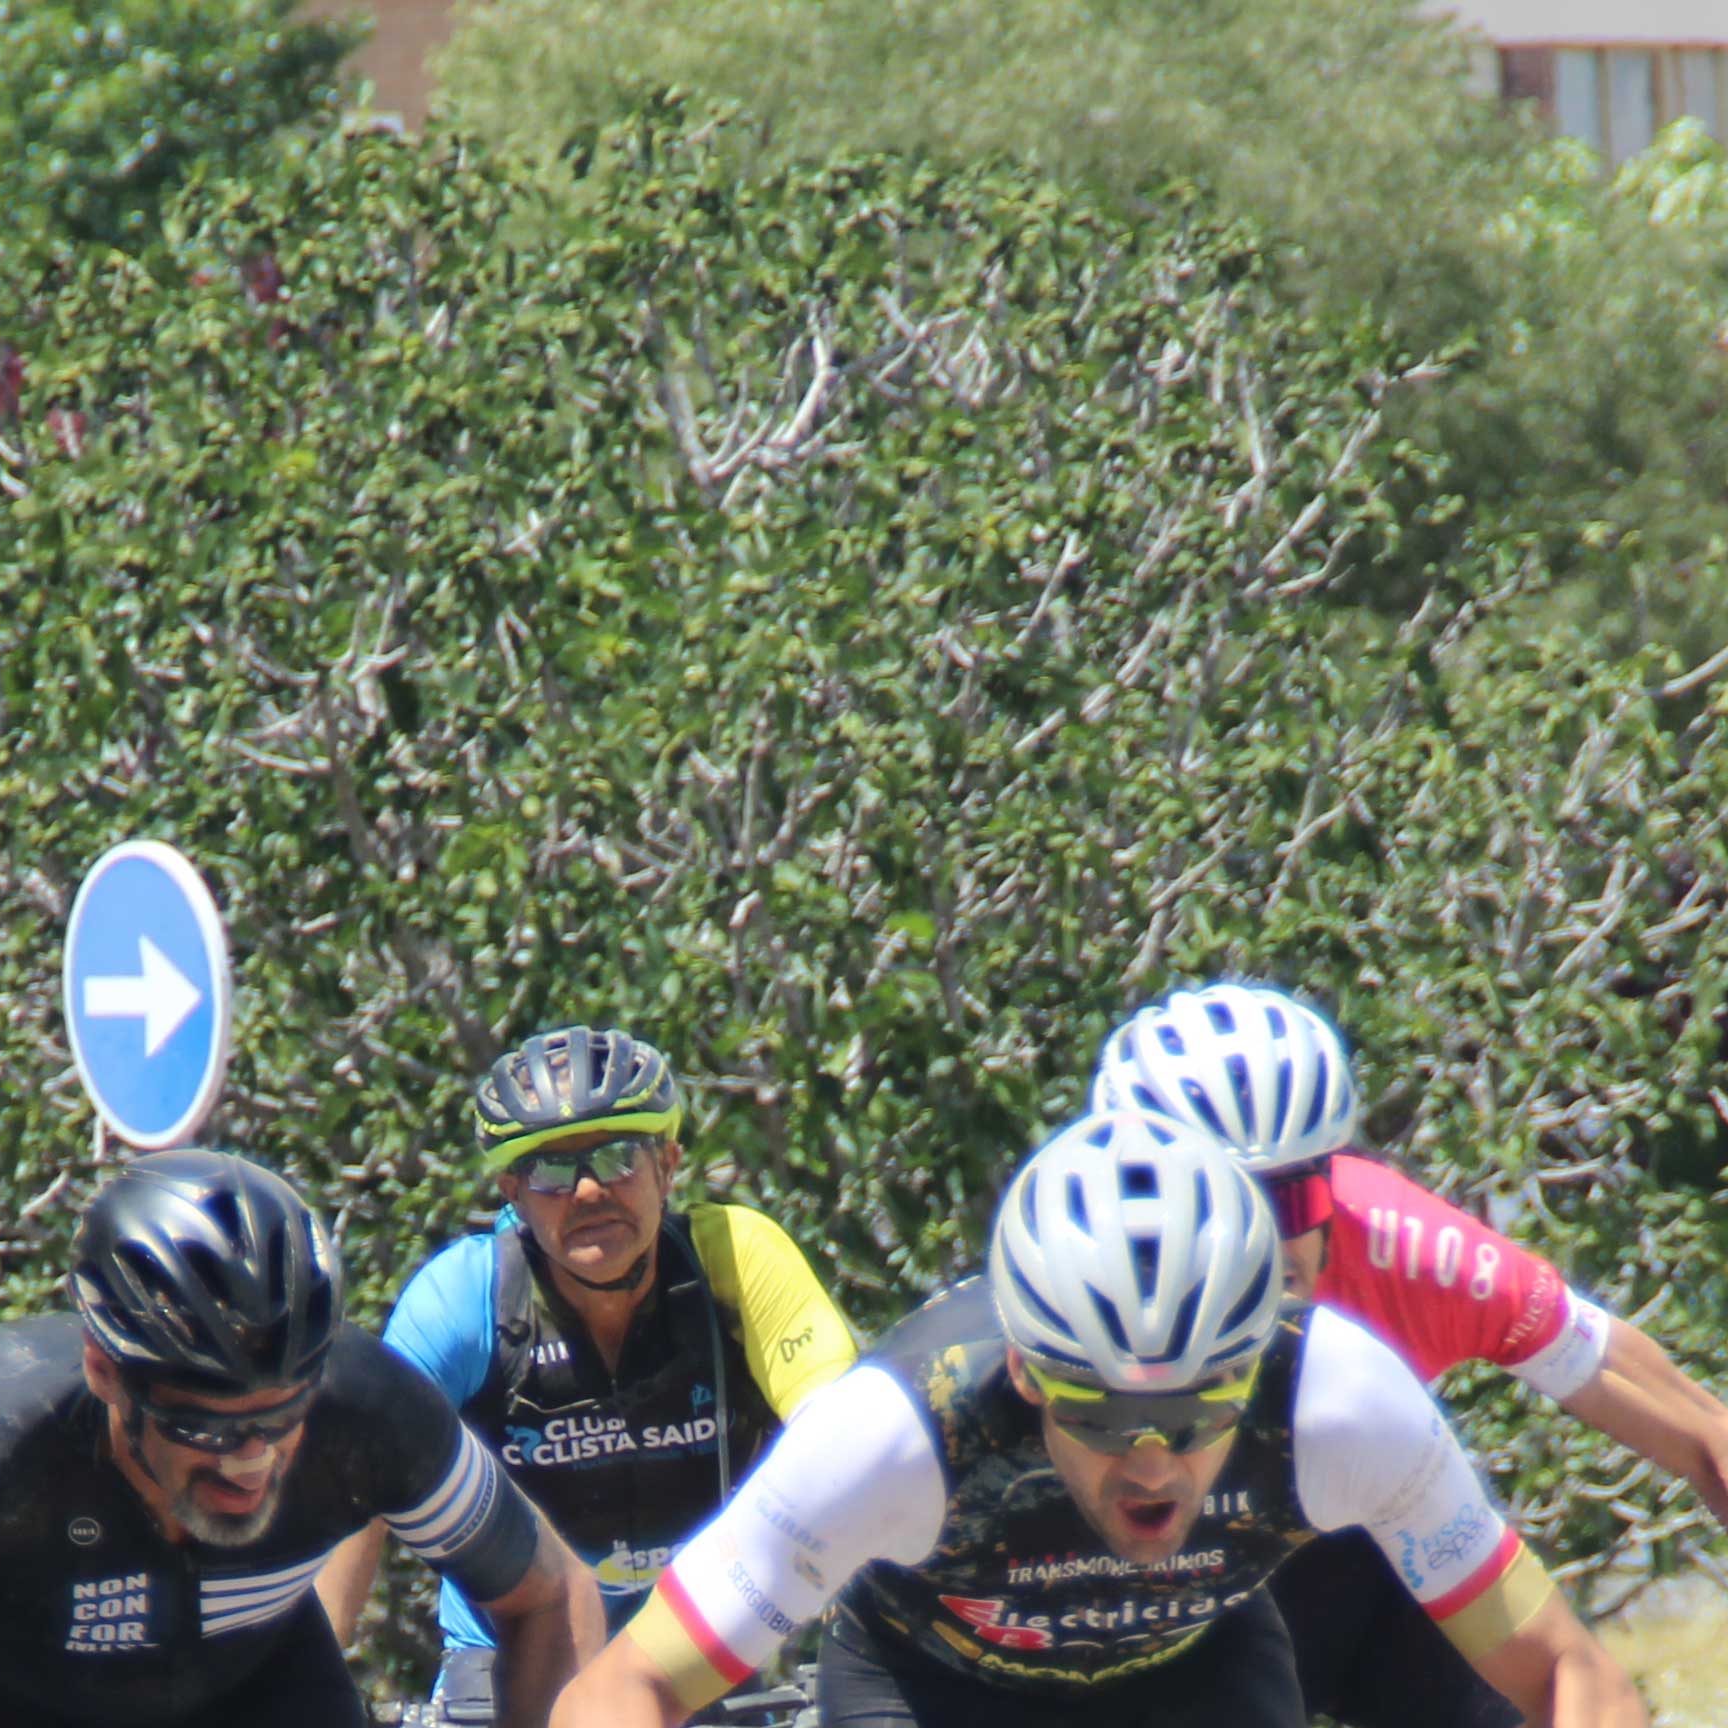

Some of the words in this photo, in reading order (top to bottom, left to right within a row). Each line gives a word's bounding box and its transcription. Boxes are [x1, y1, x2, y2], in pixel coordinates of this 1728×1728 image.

[643, 1417, 718, 1448] SAID
[73, 1573, 149, 1600] NON
[73, 1594, 148, 1621] CON
[70, 1622, 146, 1642] FOR
